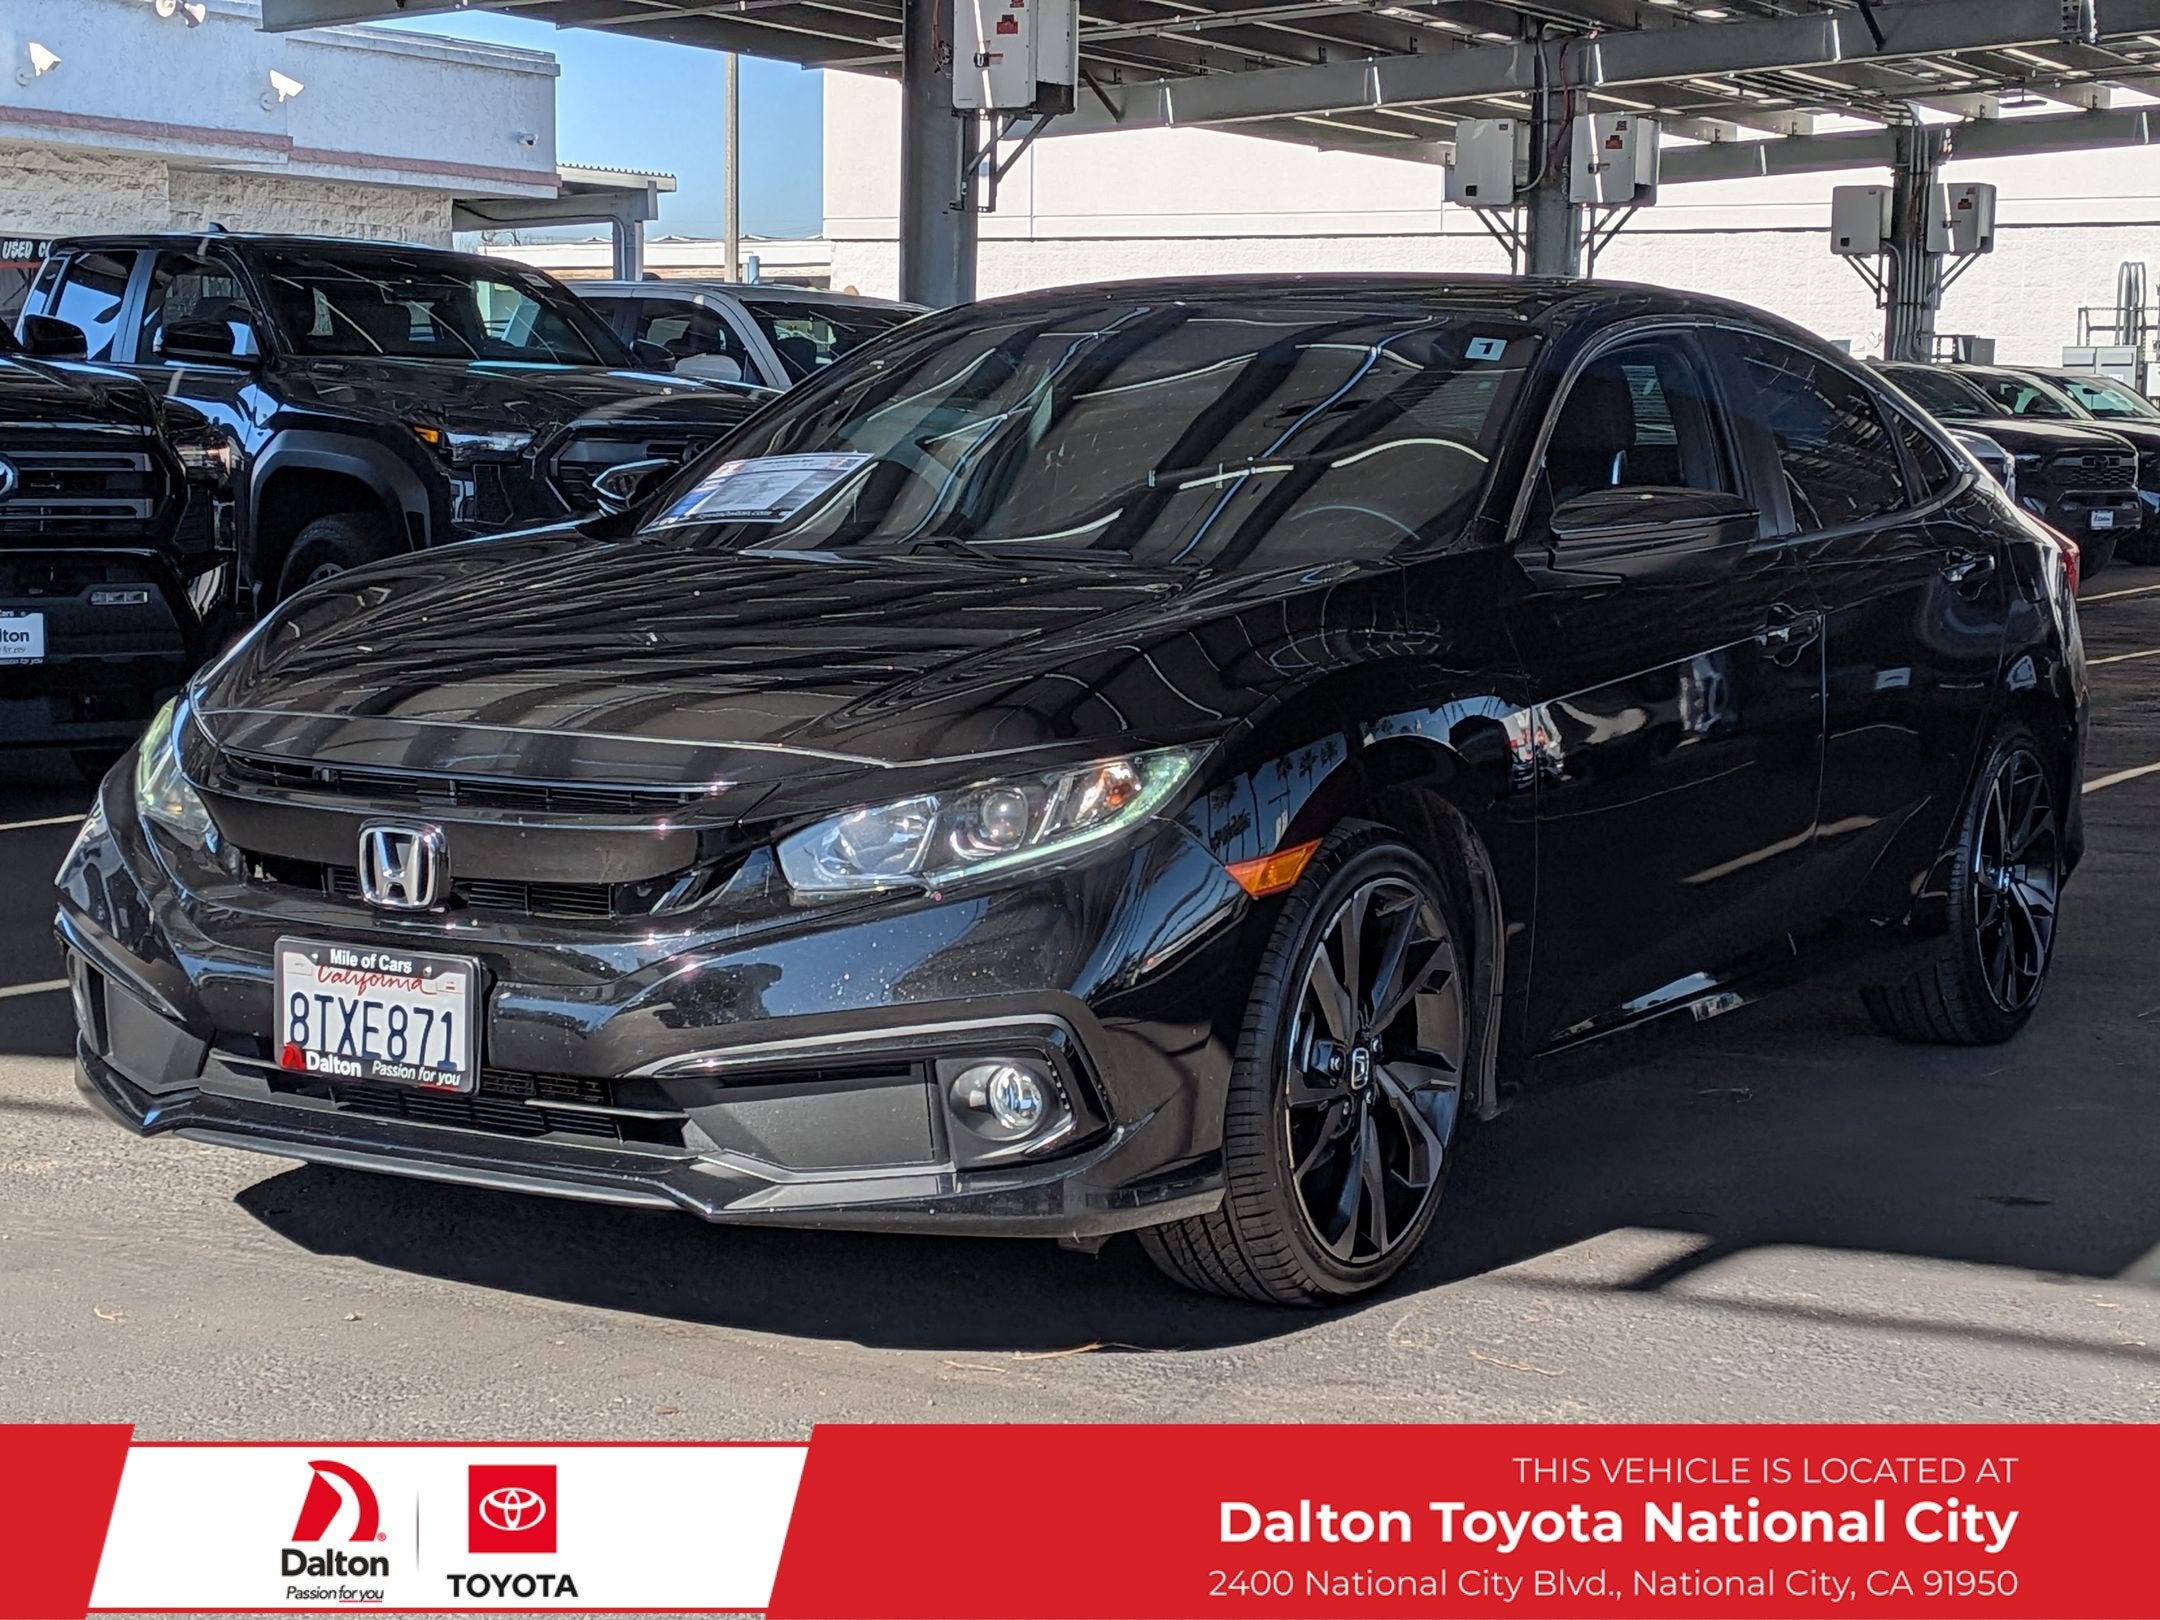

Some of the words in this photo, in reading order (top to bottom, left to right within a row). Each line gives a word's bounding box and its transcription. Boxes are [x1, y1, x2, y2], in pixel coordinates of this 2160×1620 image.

[2, 240, 33, 259] USED
[330, 949, 359, 966] Mile
[361, 953, 377, 969] of
[379, 954, 412, 974] Cars
[317, 965, 437, 996] California
[290, 992, 458, 1070] 8TXE871
[306, 1051, 362, 1078] Dalton
[372, 1060, 415, 1080] Passion
[418, 1066, 435, 1082] for
[437, 1072, 460, 1087] you
